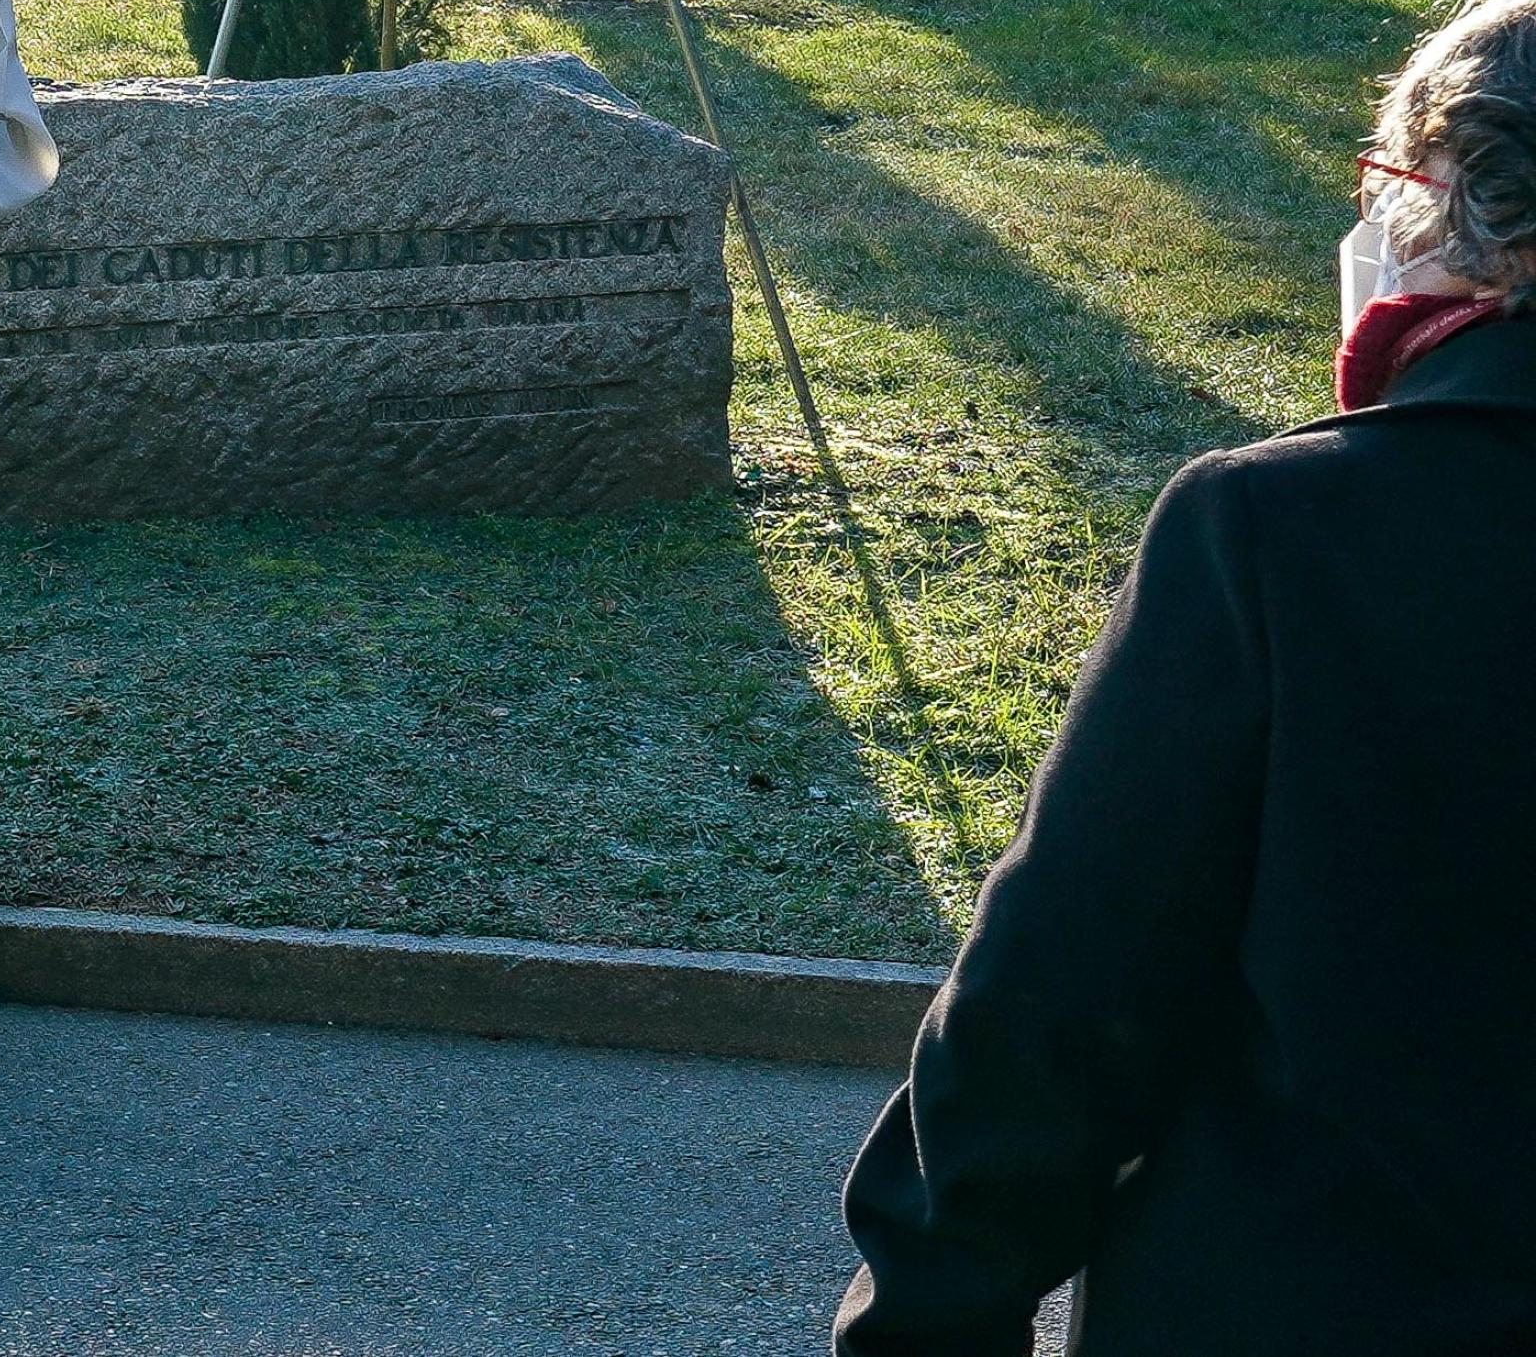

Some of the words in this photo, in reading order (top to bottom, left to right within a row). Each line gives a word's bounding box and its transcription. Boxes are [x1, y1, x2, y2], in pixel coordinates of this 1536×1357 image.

[8, 255, 79, 290] DEI
[103, 245, 261, 283] CADUTI
[284, 237, 421, 273] DELLA
[442, 220, 684, 267] RESISTENZA
[377, 393, 494, 419] THOMAS
